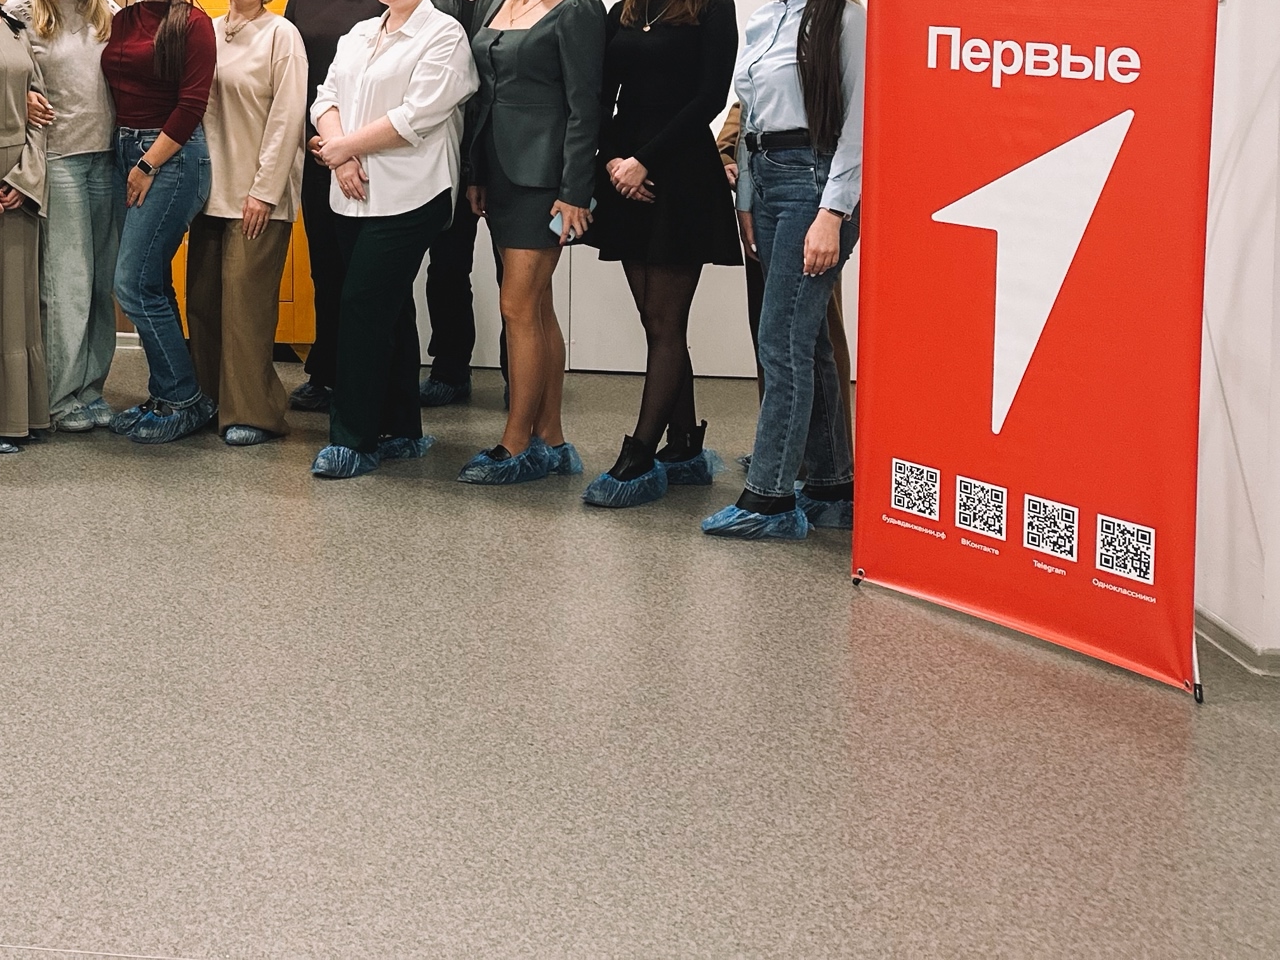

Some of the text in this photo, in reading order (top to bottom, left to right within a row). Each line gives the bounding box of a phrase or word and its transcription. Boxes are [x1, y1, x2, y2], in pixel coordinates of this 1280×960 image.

[926, 25, 1142, 88] Первые
[960, 537, 1000, 556] ВКонтакте
[1032, 559, 1067, 576] Telegram
[1091, 577, 1157, 604] Одноклассники
